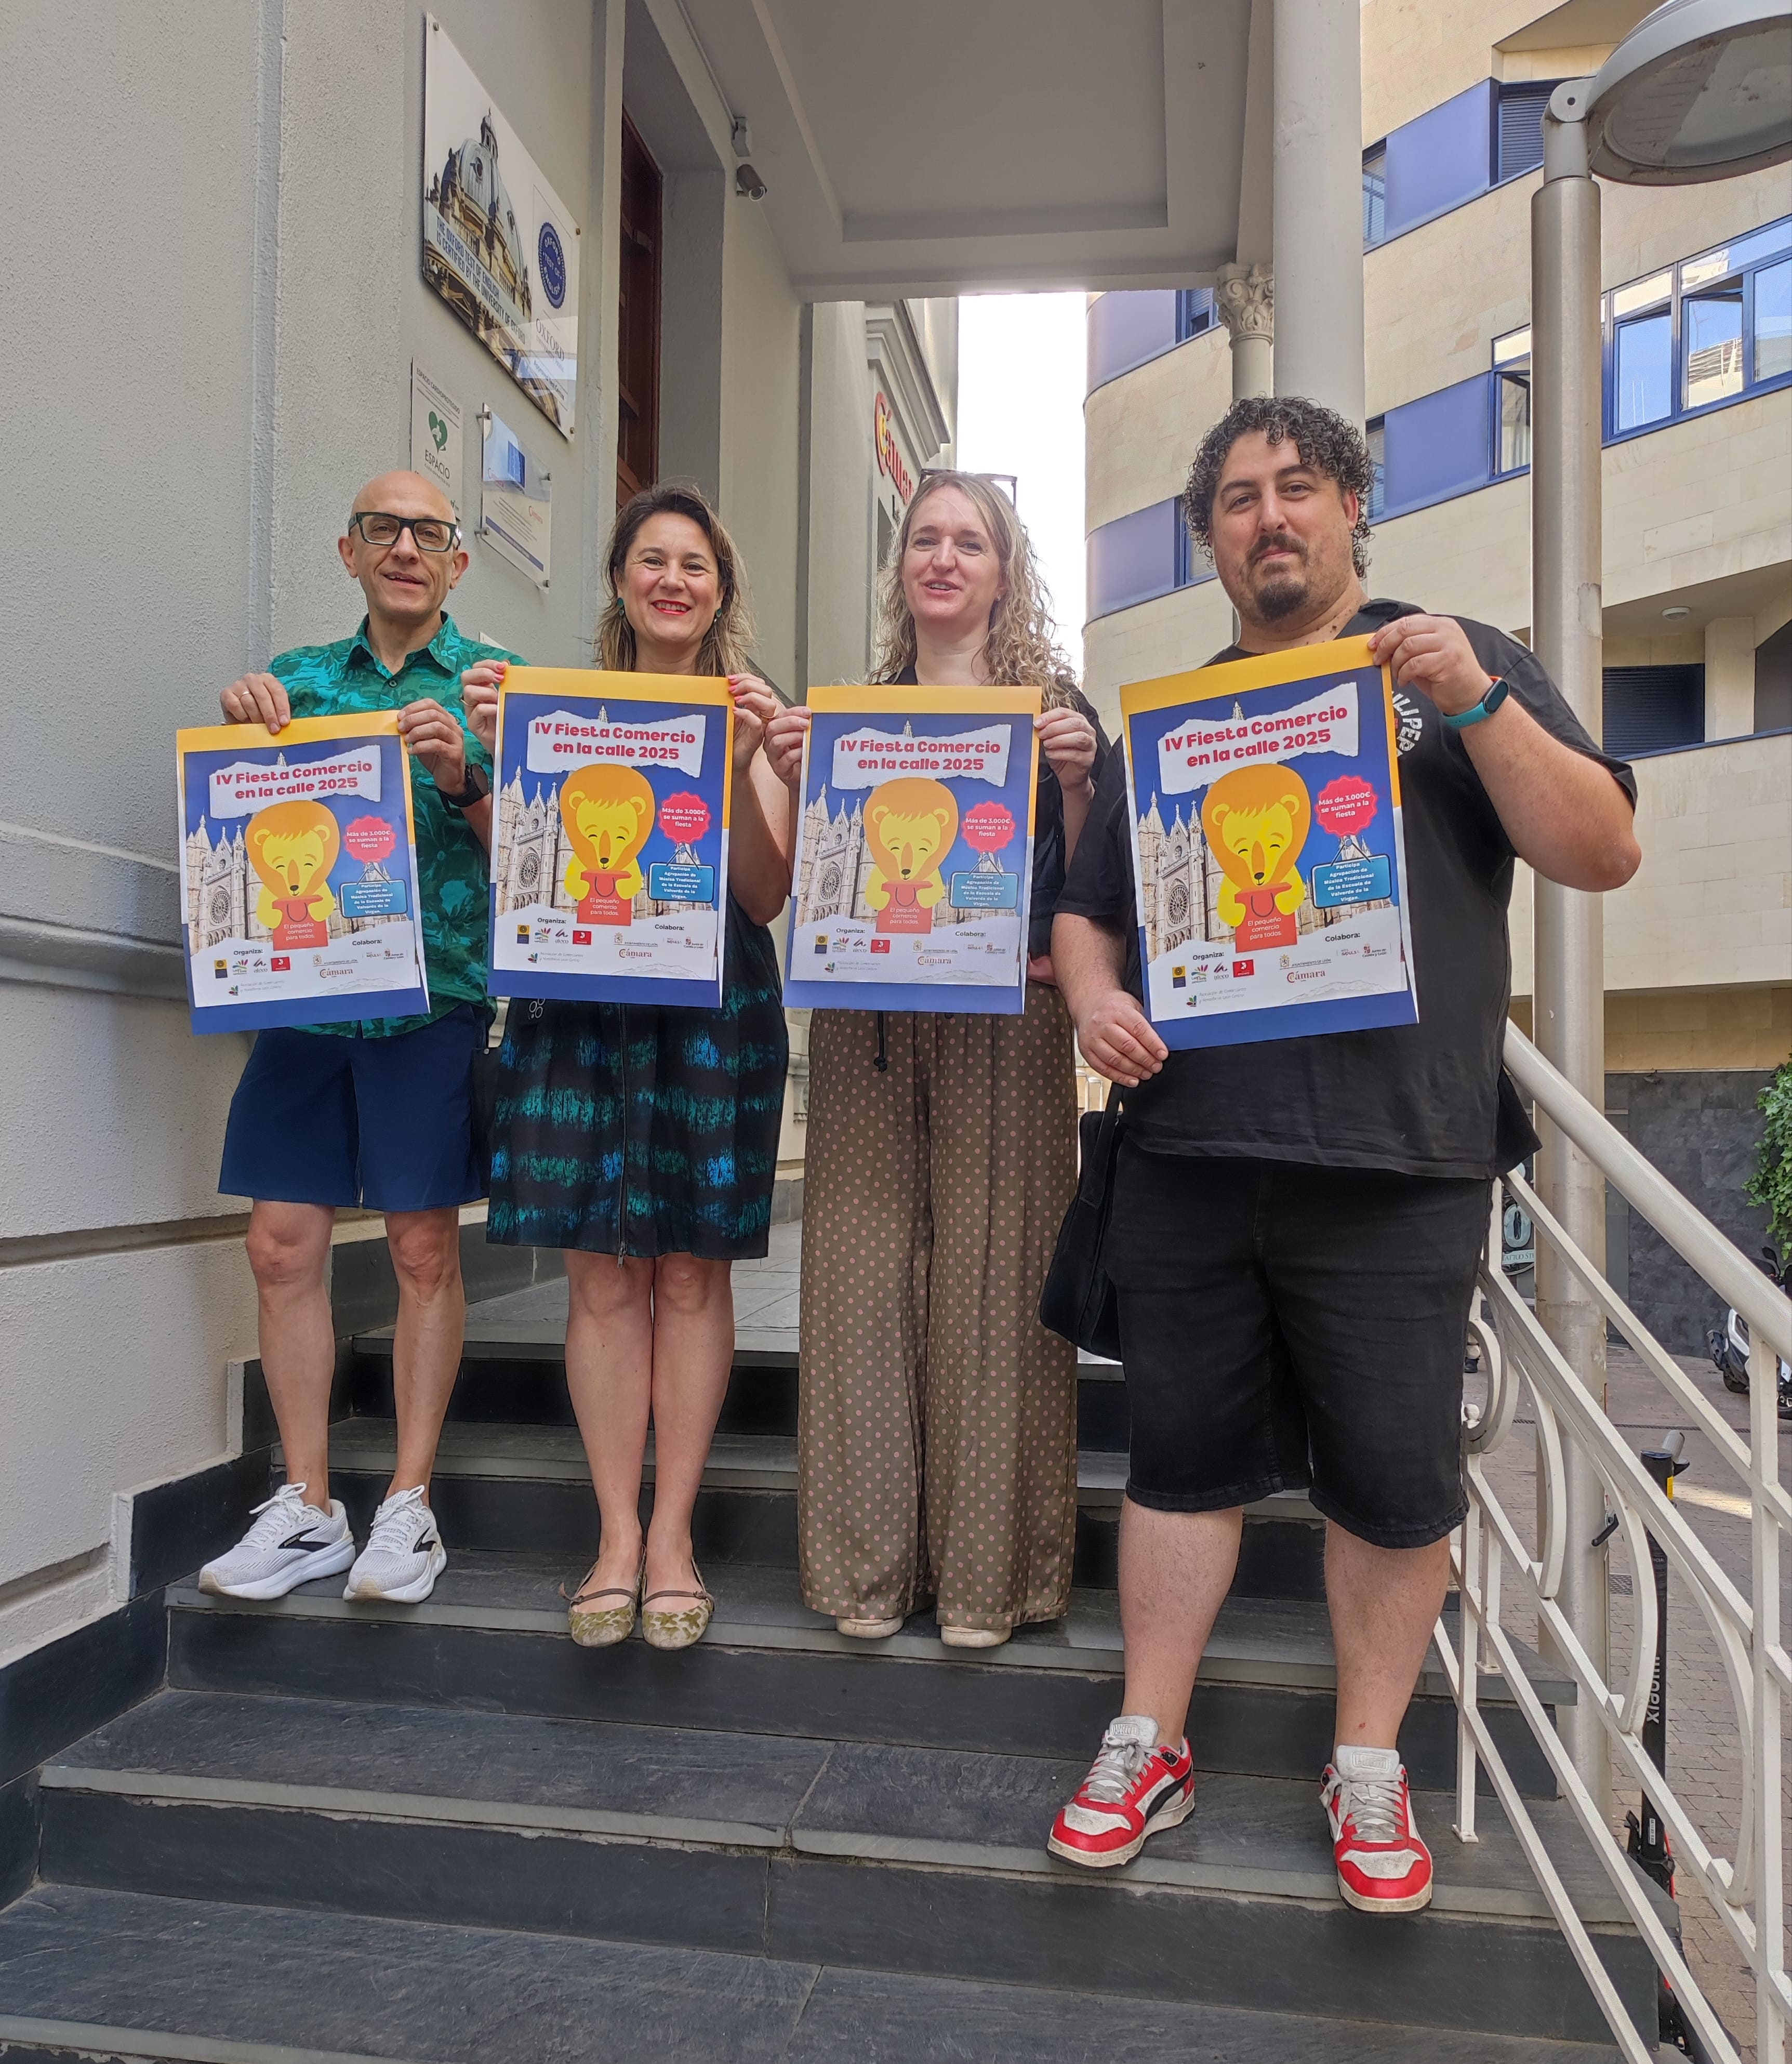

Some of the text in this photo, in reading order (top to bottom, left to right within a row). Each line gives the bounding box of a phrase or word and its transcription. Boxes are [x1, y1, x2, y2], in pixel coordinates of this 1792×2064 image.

[436, 216, 499, 299] THE OXFORD TEST OF ENGLISH
[544, 236, 561, 265] OXFORD
[545, 253, 561, 277] TEST OF
[436, 231, 442, 246] IS
[443, 239, 465, 273] CERTIFIED
[466, 267, 471, 280] BY
[482, 284, 505, 319] UNIVERSITY
[505, 313, 510, 325] OF
[543, 266, 561, 296] ENGLISH
[536, 318, 565, 362] OXFORD
[425, 449, 450, 480] ESPACIO
[535, 722, 696, 743] IV Fiesta Comercio
[1165, 706, 1347, 752] IV Fiesta Comercio
[553, 743, 679, 759] en la calle 2025
[841, 740, 1001, 753] IV Fiesta Comercio
[1187, 729, 1331, 767] en la calle 2025
[216, 761, 373, 785] IV Fiesta Comercio
[858, 758, 984, 770] en la calle 2025
[235, 777, 359, 799] en la calle 2025
[1345, 791, 1371, 801] 3.000€
[1331, 803, 1355, 811] suman
[1255, 917, 1281, 926] pequeño
[1325, 933, 1360, 942] Colabora:
[619, 948, 652, 958] Cámara
[918, 956, 951, 965] Cámara
[1193, 952, 1225, 960] Organiza:
[320, 968, 353, 978] Cámara
[1287, 970, 1325, 983] Cámara
